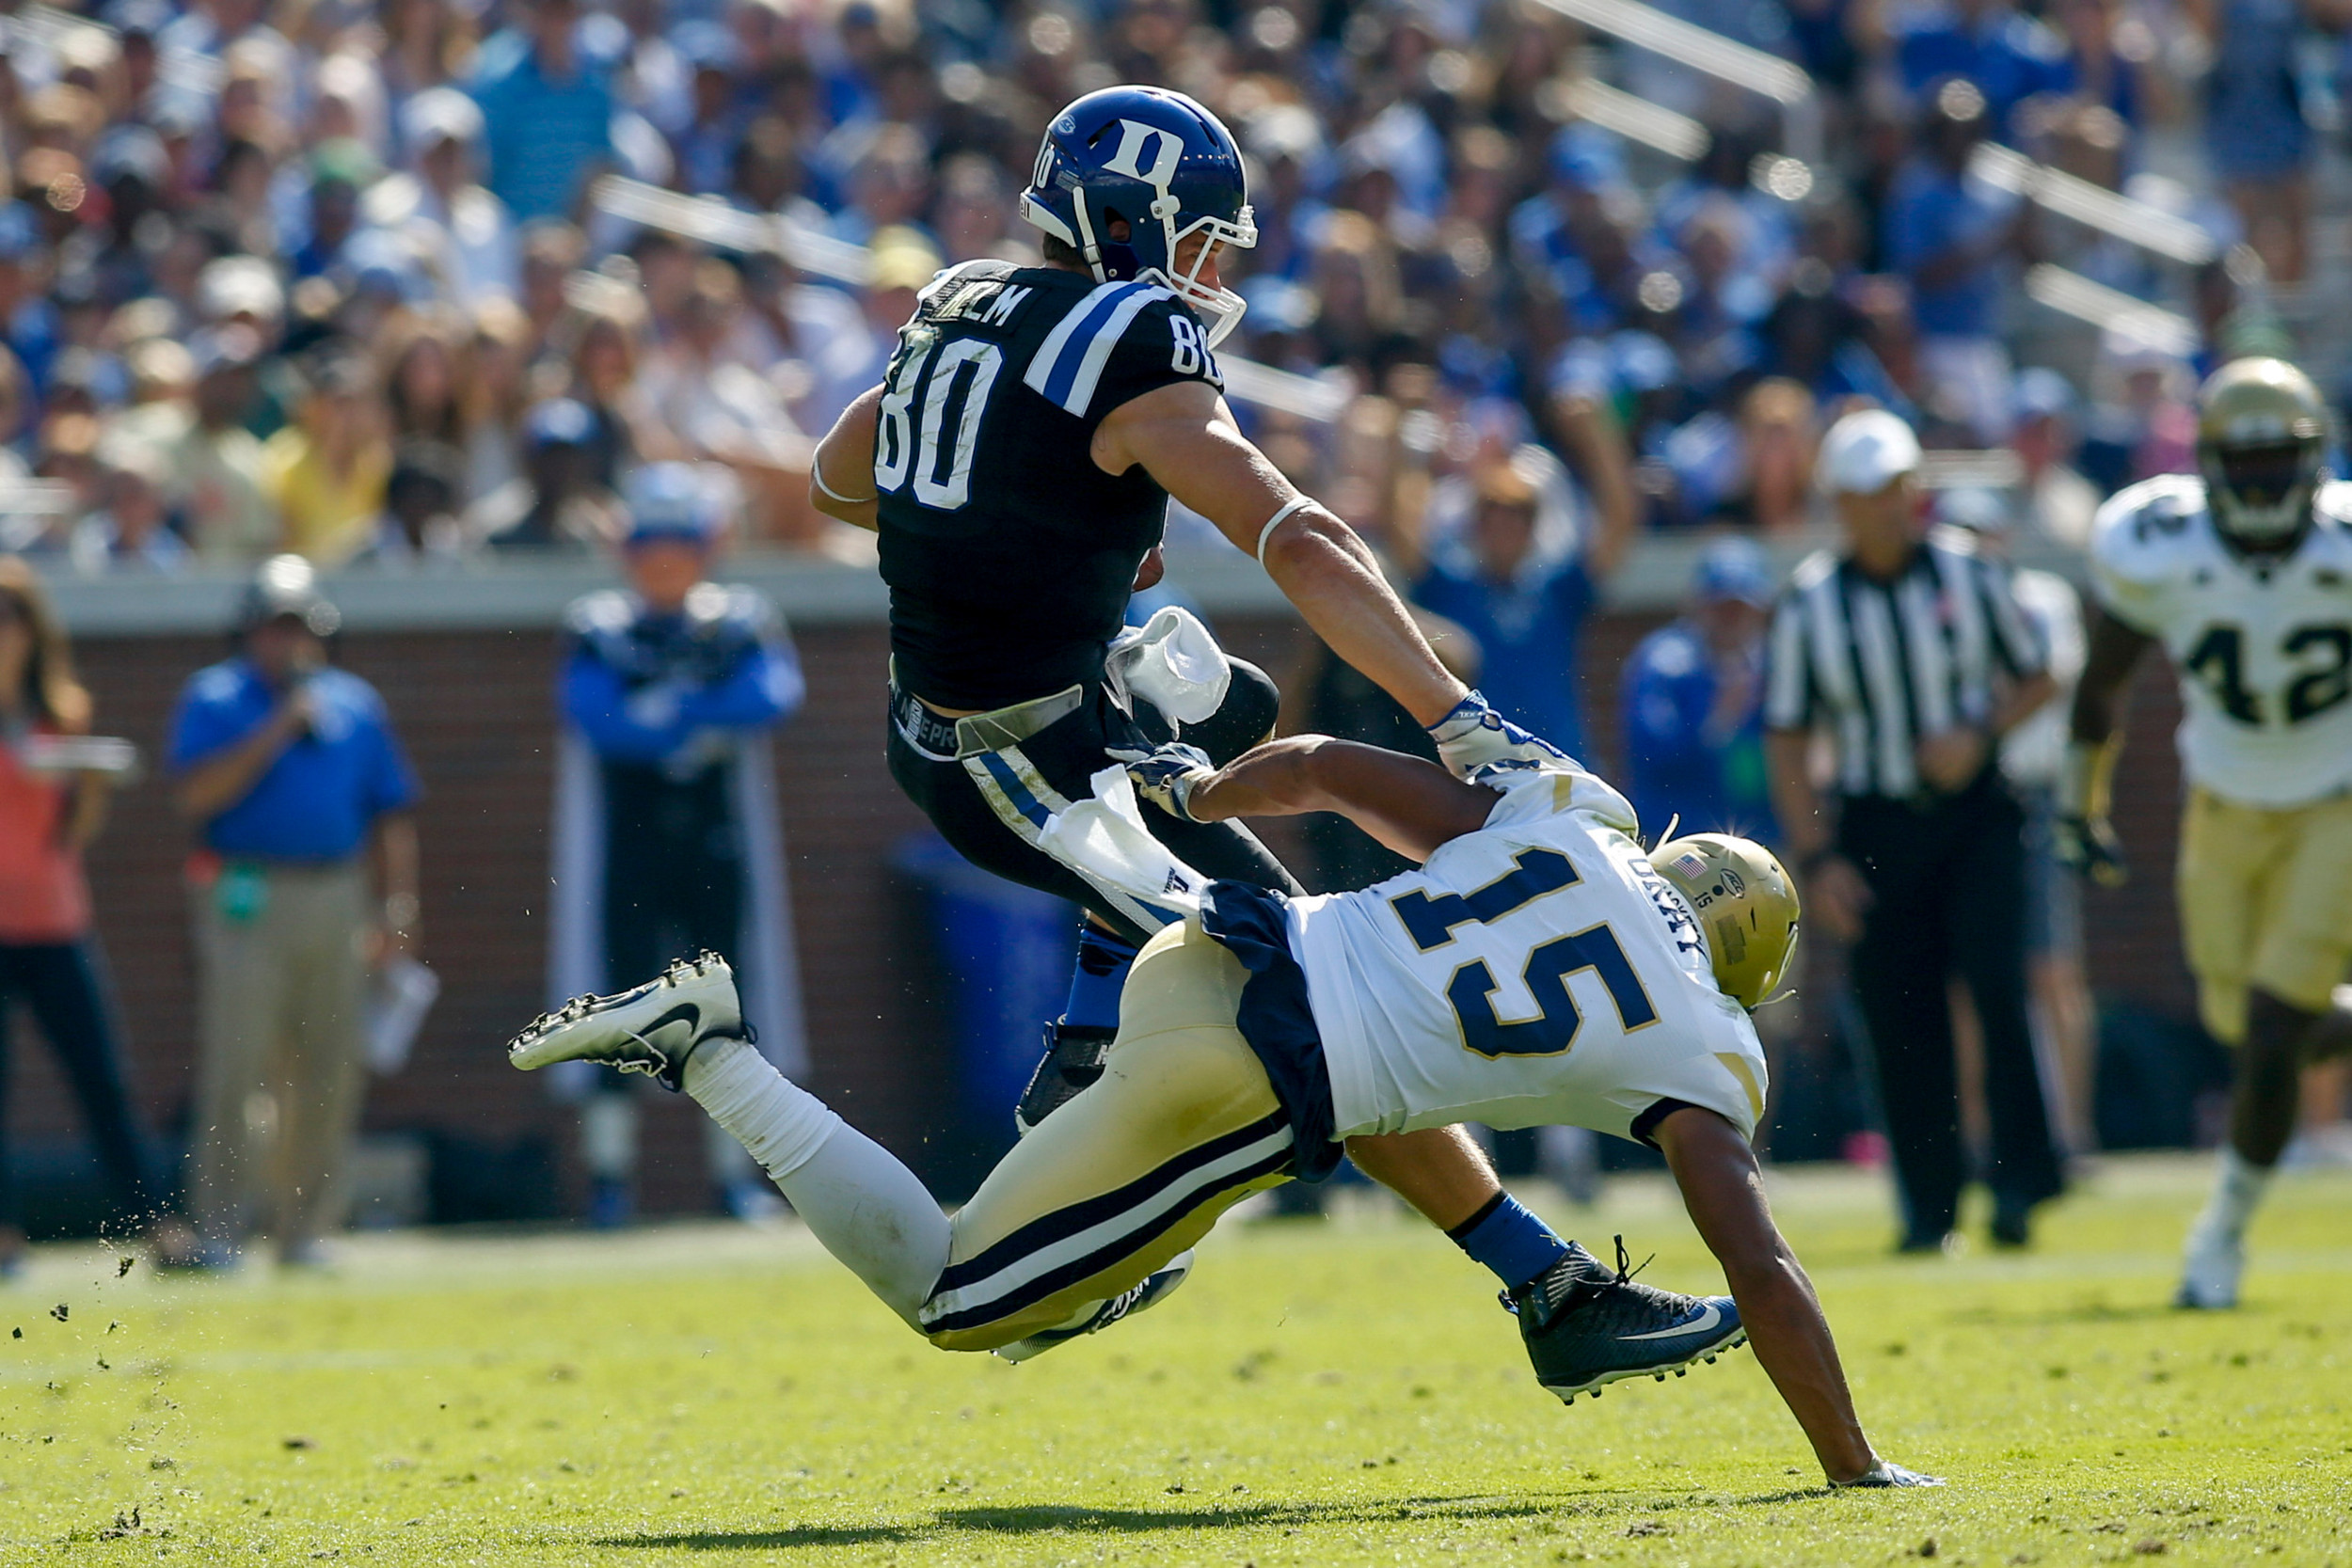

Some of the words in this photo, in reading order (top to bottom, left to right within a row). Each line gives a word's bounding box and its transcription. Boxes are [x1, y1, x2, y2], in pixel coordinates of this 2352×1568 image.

[874, 328, 1006, 512] 80
[2187, 622, 2352, 726] 42
[1694, 891, 1713, 909] 15
[1725, 872, 1742, 894] ACC
[1390, 846, 1661, 1061] 15
